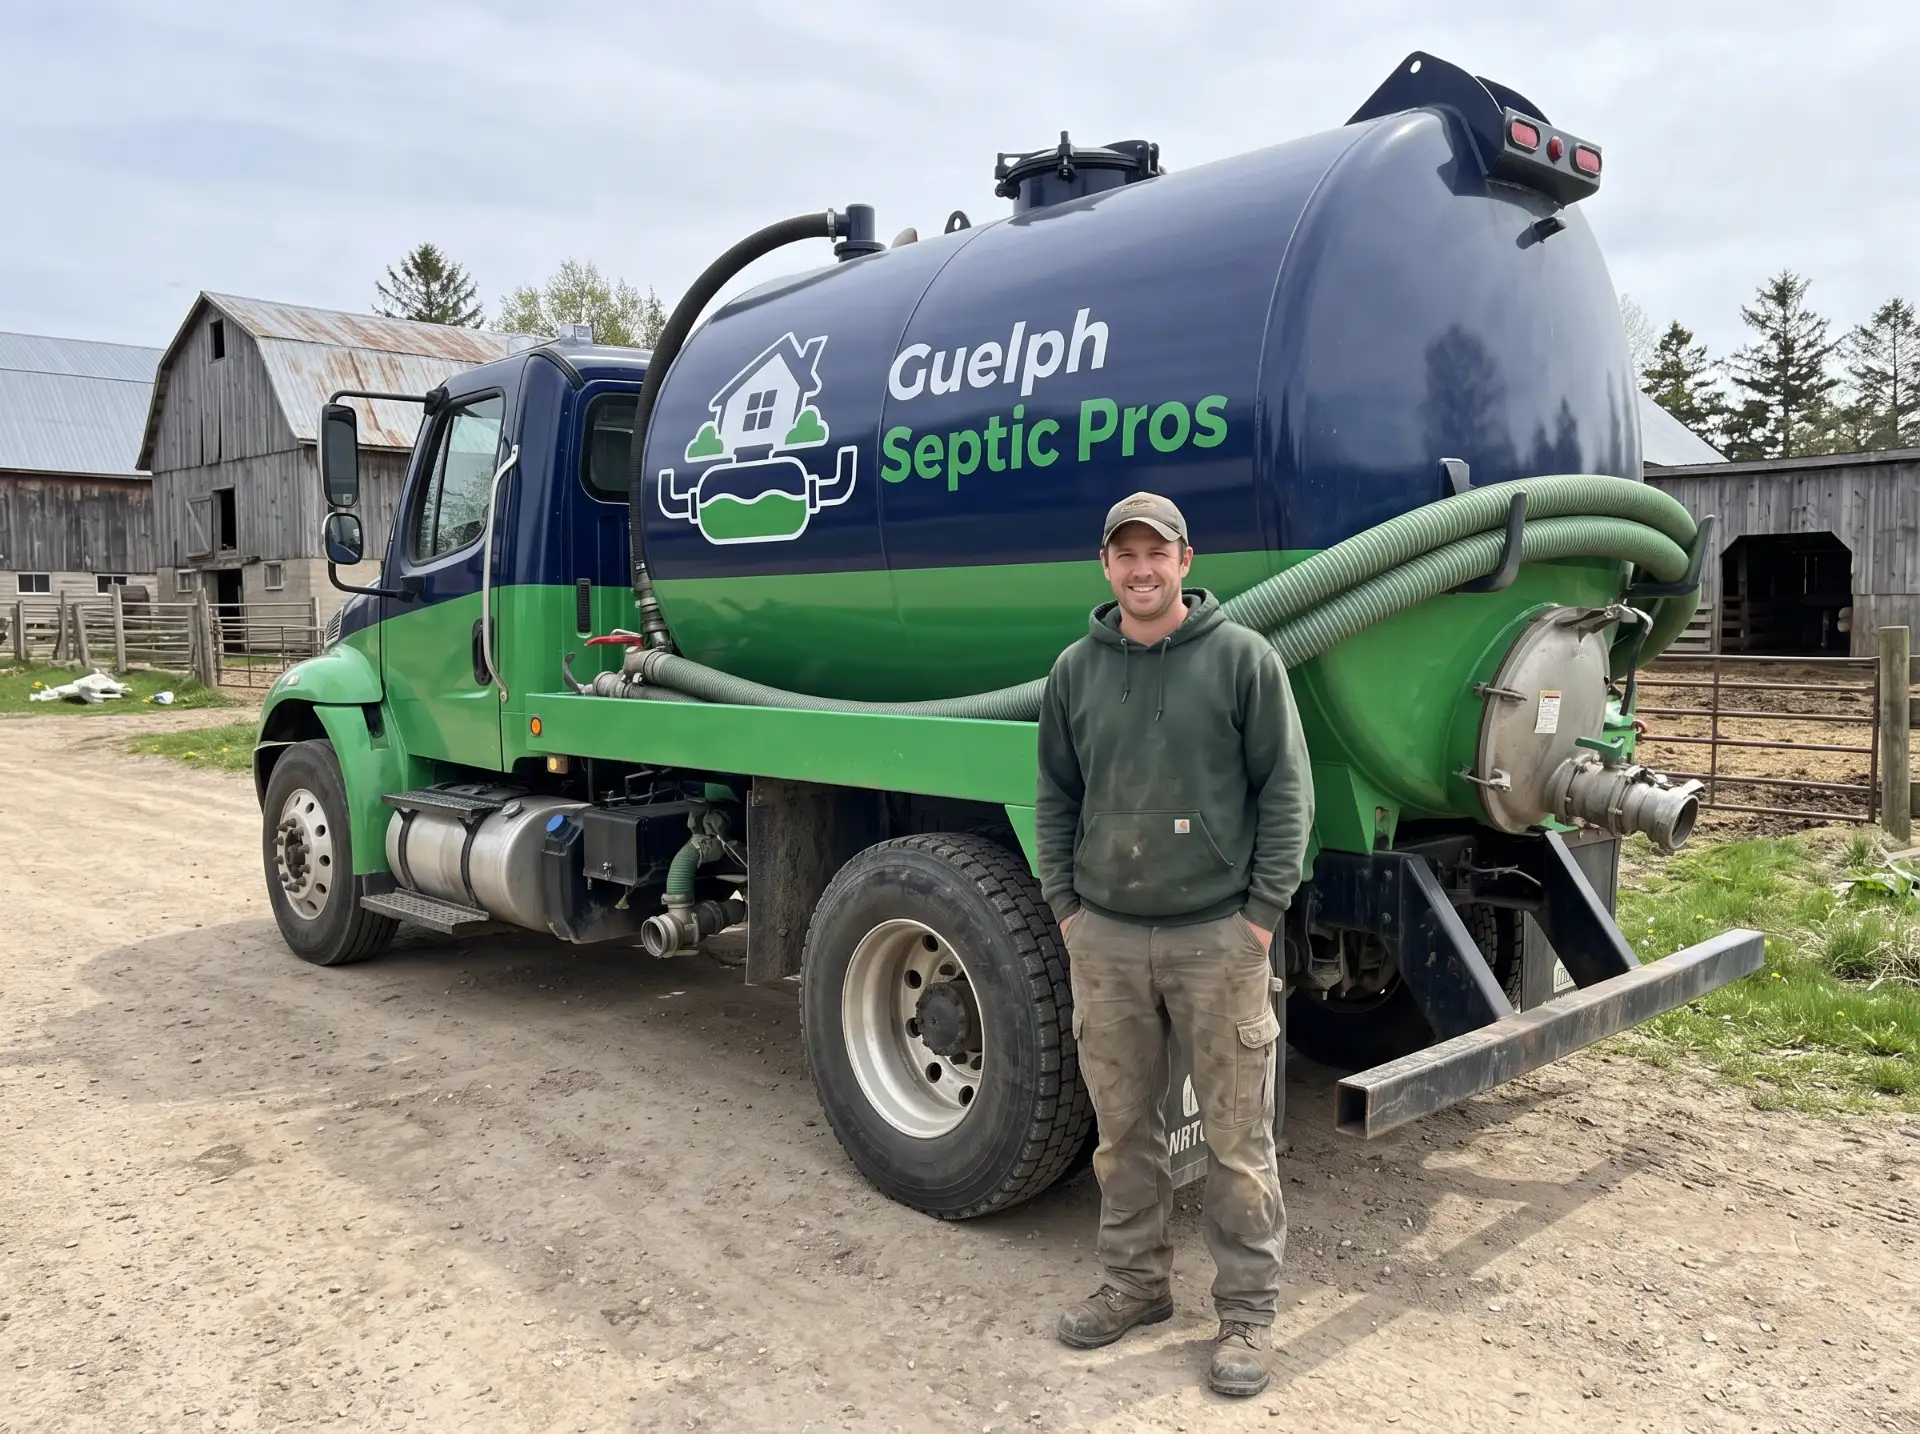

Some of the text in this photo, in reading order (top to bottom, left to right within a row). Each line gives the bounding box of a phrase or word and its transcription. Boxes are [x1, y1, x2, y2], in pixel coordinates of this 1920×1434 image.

[888, 307, 1109, 400] Guelph
[880, 395, 1228, 491] Septic Pros
